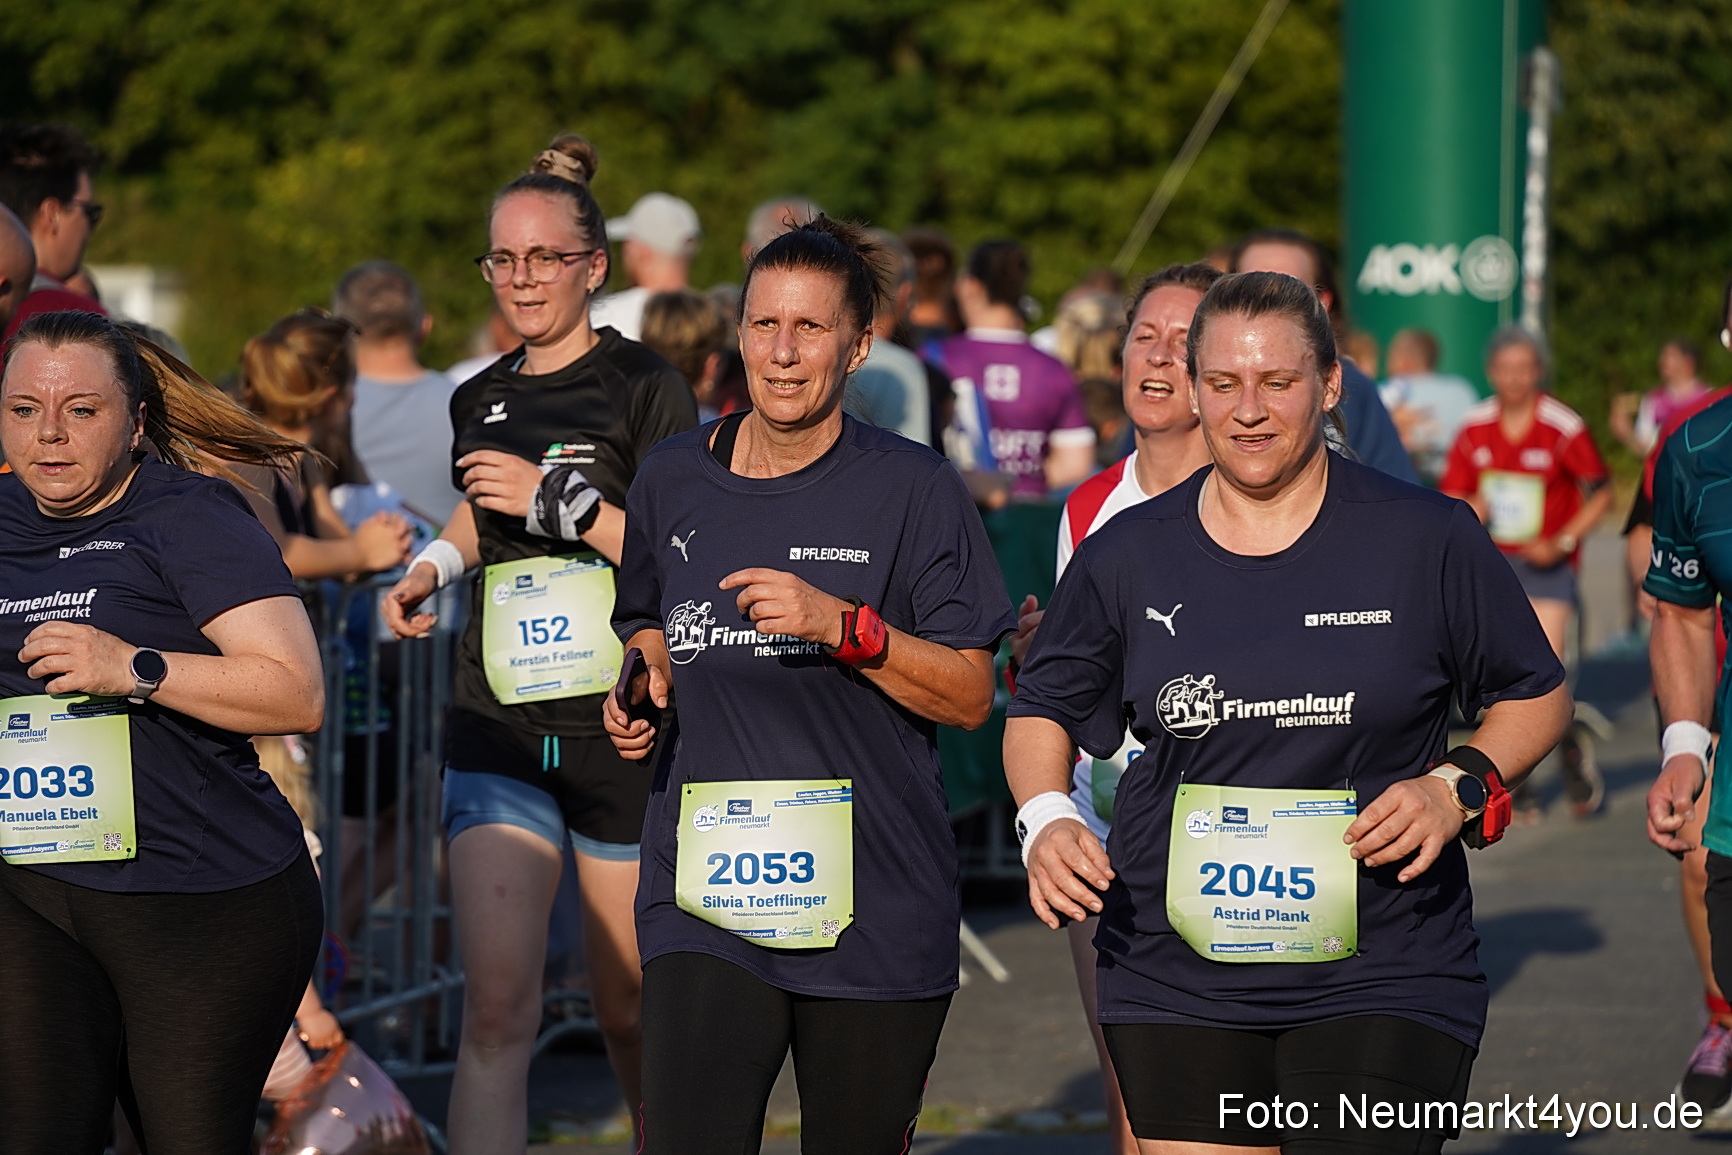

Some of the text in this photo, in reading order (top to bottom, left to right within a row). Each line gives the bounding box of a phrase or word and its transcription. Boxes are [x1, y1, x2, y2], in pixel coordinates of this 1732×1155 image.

[1357, 243, 1463, 295] AOK
[802, 548, 870, 564] PFLEIDERER
[1669, 552, 1700, 579] '26
[24, 606, 92, 623] neumarkt
[1320, 610, 1392, 626] PFLEIDERER
[518, 616, 572, 646] 152
[710, 627, 805, 646] Firmen
[754, 642, 820, 657] neumarkt
[509, 650, 594, 667] Kerstin Fellner
[1223, 692, 1355, 720] Firmenlauf
[1275, 711, 1351, 728] neumarkt
[0, 727, 47, 740] Firmenlauf
[17, 736, 47, 744] neumarkt
[61, 806, 98, 820] Ebelt
[720, 813, 771, 825] Firmenlauf
[1214, 824, 1269, 833] Firmenlauf
[707, 852, 815, 885] 2053
[1200, 862, 1315, 900] 2045
[703, 894, 827, 909] Silvia Toefflinger
[1213, 906, 1310, 922] Astrid Plank
